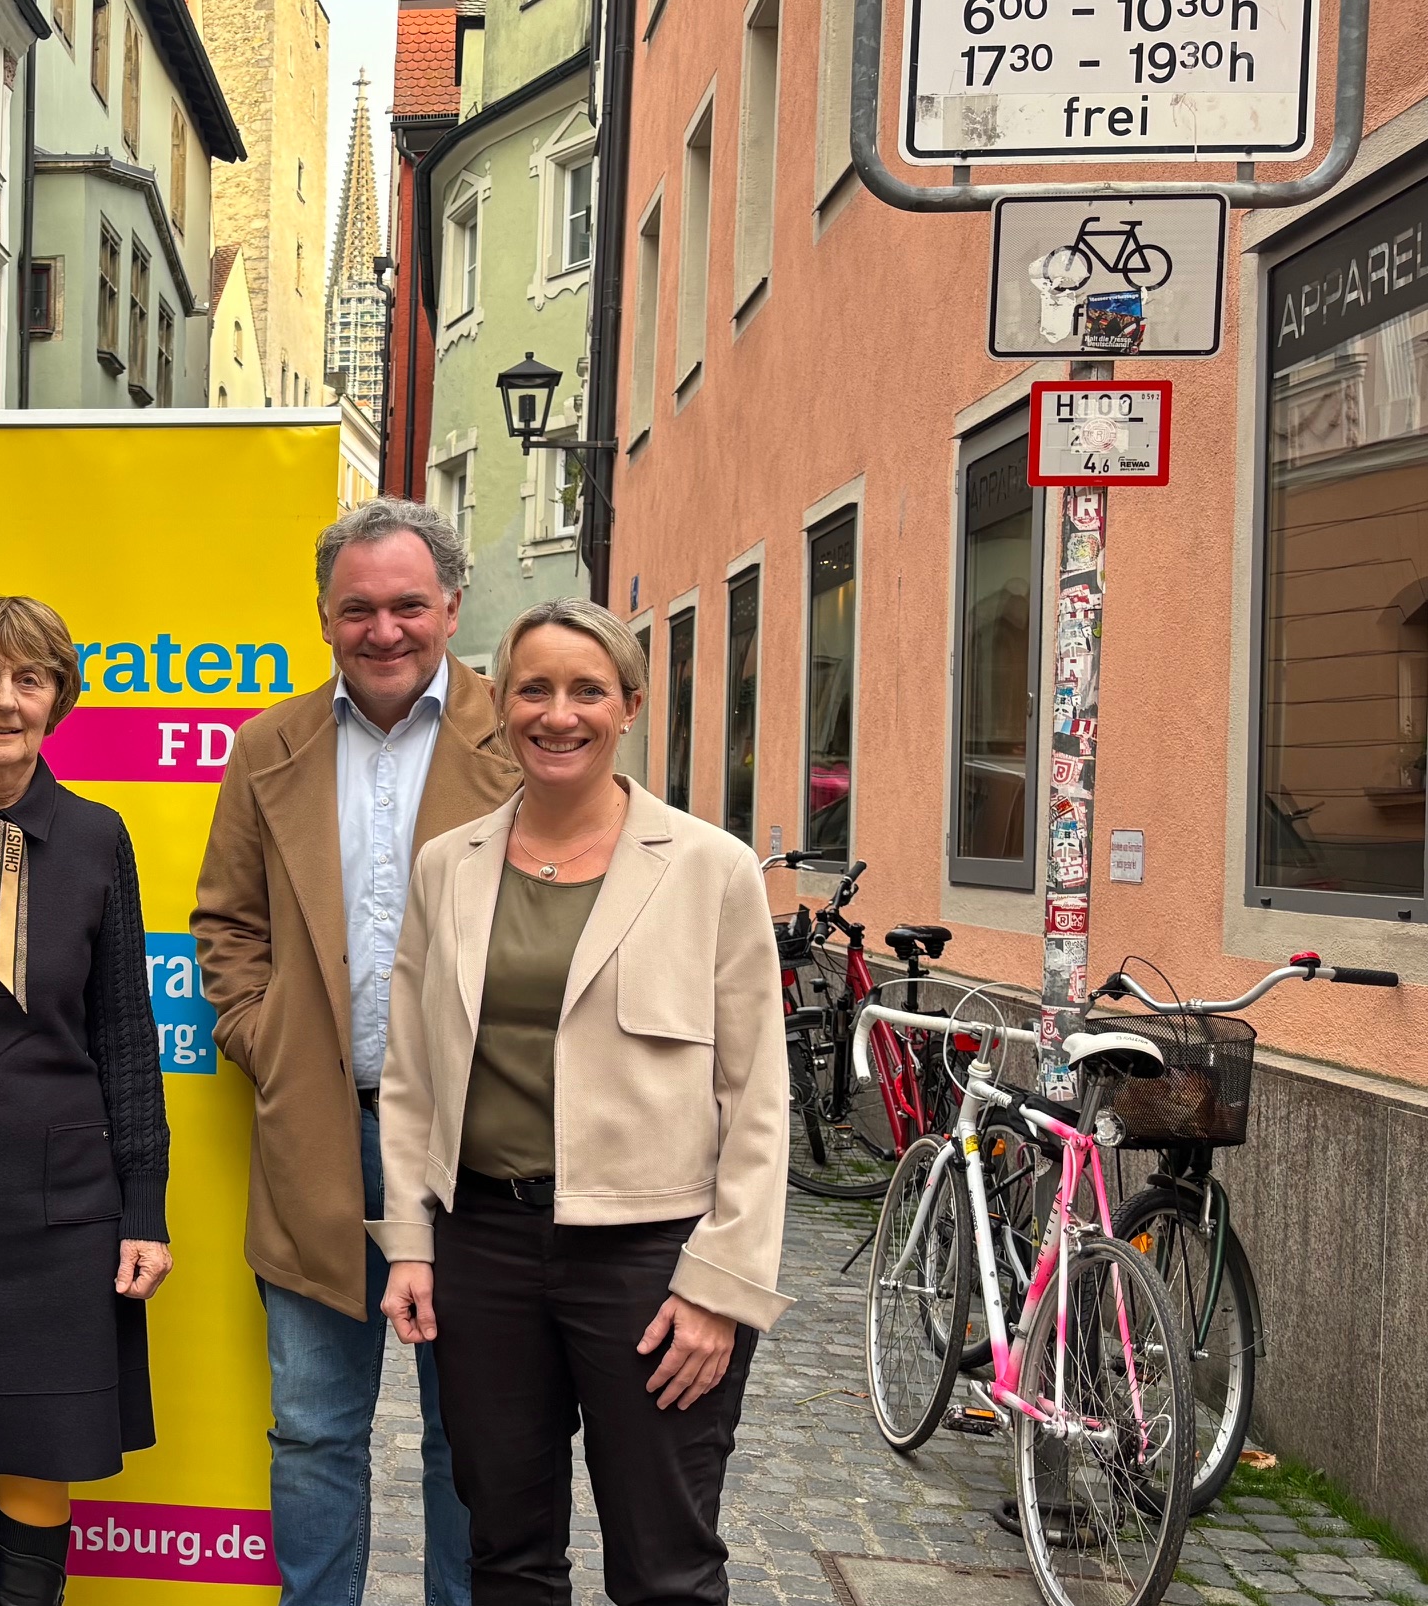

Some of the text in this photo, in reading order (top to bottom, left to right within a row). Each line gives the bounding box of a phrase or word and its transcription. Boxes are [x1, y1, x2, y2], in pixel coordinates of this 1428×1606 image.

[1063, 95, 1149, 138] frei
[1278, 222, 1428, 347] APPAREL
[158, 722, 236, 767] FD
[157, 1023, 207, 1065] rg.
